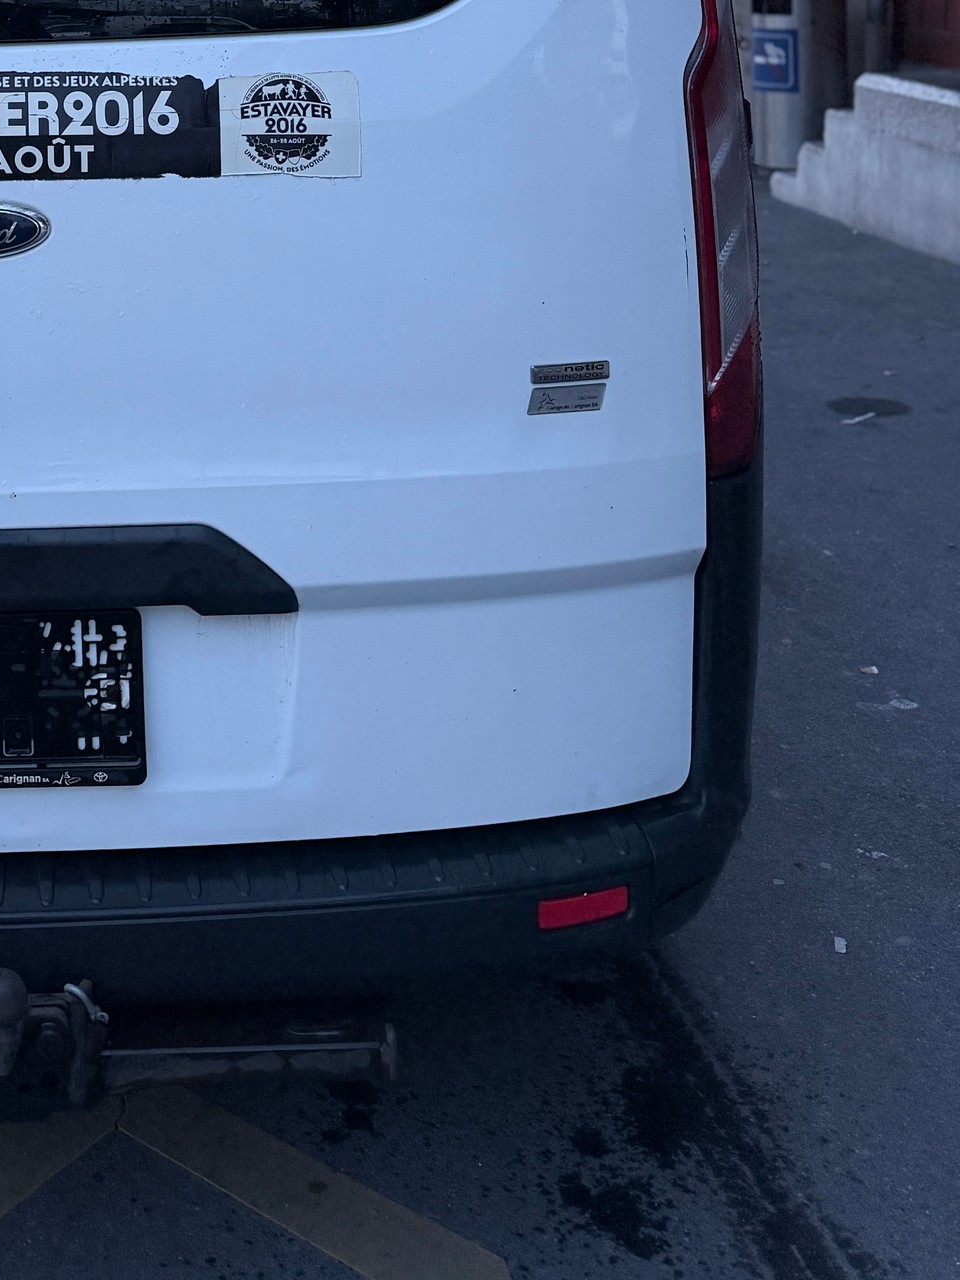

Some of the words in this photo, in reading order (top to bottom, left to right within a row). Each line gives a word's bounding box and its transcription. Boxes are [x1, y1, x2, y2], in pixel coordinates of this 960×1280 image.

[14, 76, 30, 88] ET
[34, 76, 60, 88] DES
[62, 75, 100, 87] JEUX
[102, 75, 178, 87] ALPESTRES
[240, 102, 332, 119] ESTAVAYER
[265, 117, 307, 133] 2016
[244, 149, 257, 162] UNE
[255, 159, 285, 172] PASSION,
[300, 149, 331, 171] ÉMOTIONS
[537, 372, 605, 381] TECHNOLOGY
